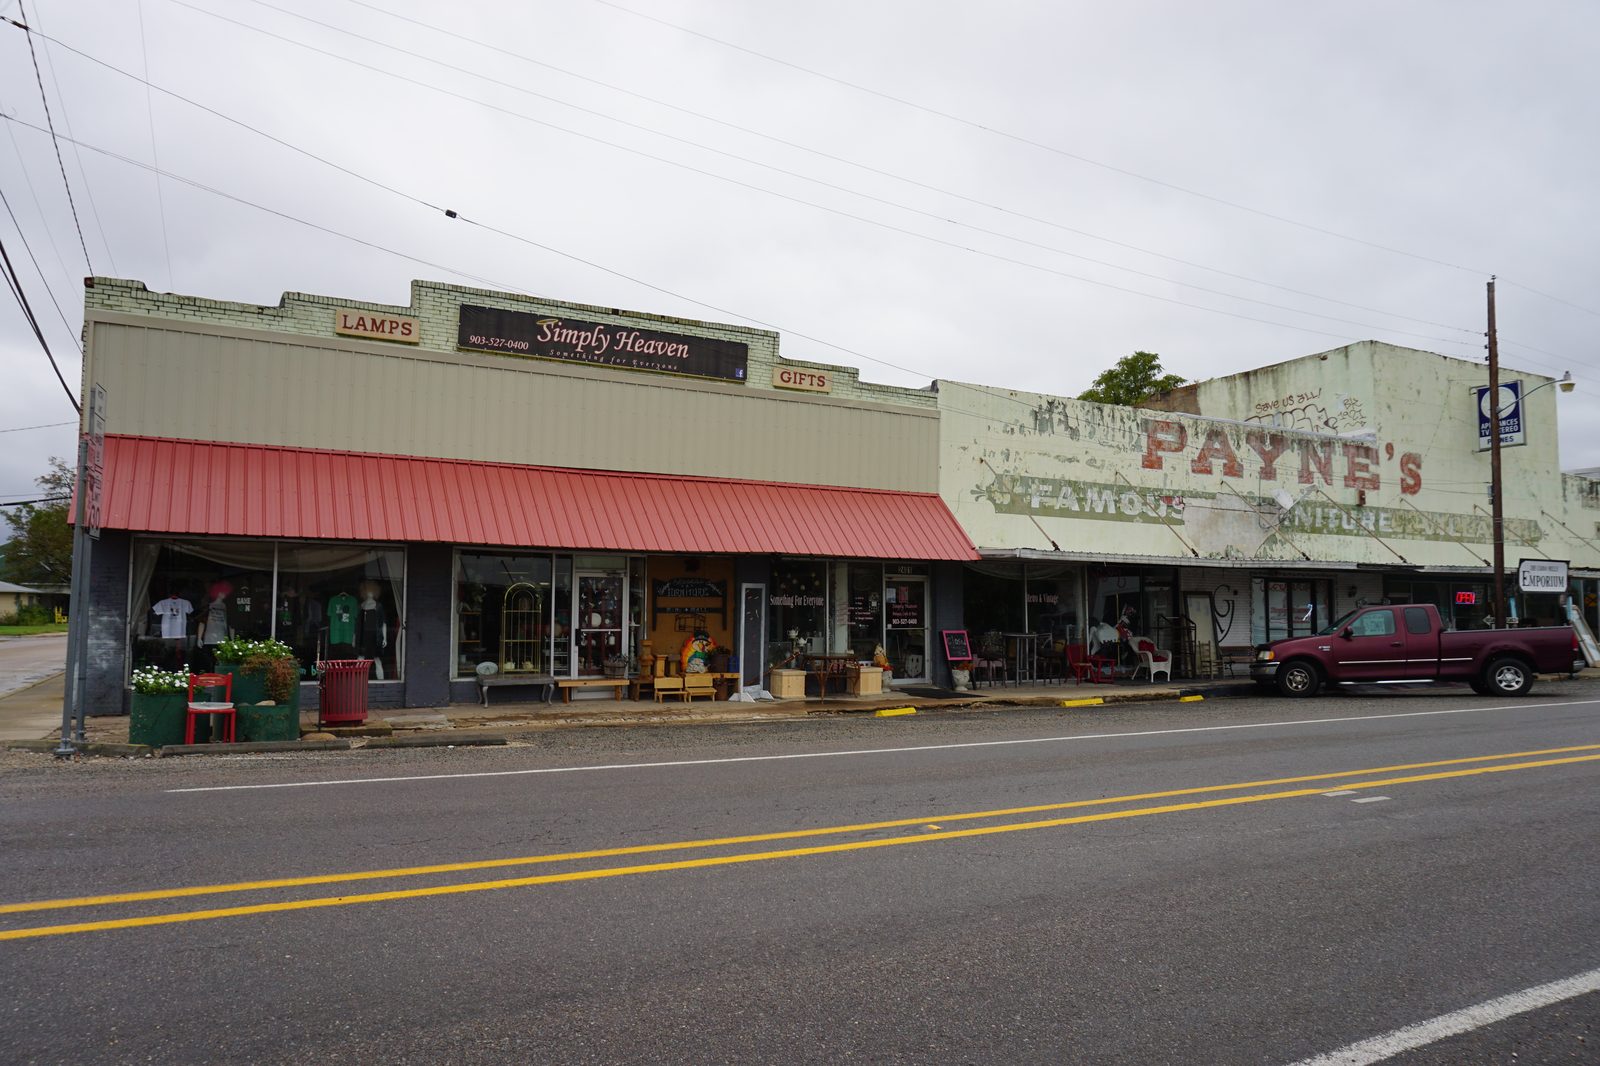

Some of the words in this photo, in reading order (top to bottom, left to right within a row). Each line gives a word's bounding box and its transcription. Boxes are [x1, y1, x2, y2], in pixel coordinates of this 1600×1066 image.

[342, 314, 412, 336] LAMPS
[469, 335, 529, 350] 903-527-0400
[537, 321, 610, 354] Simply
[613, 331, 689, 359] Heaven
[549, 349, 604, 363] Something
[780, 371, 826, 387] GIFTS
[1487, 436, 1514, 444] PNES
[1141, 419, 1422, 495] PAYNE'S
[1031, 485, 1185, 518] FAMOUS
[1456, 592, 1475, 604] OPEN
